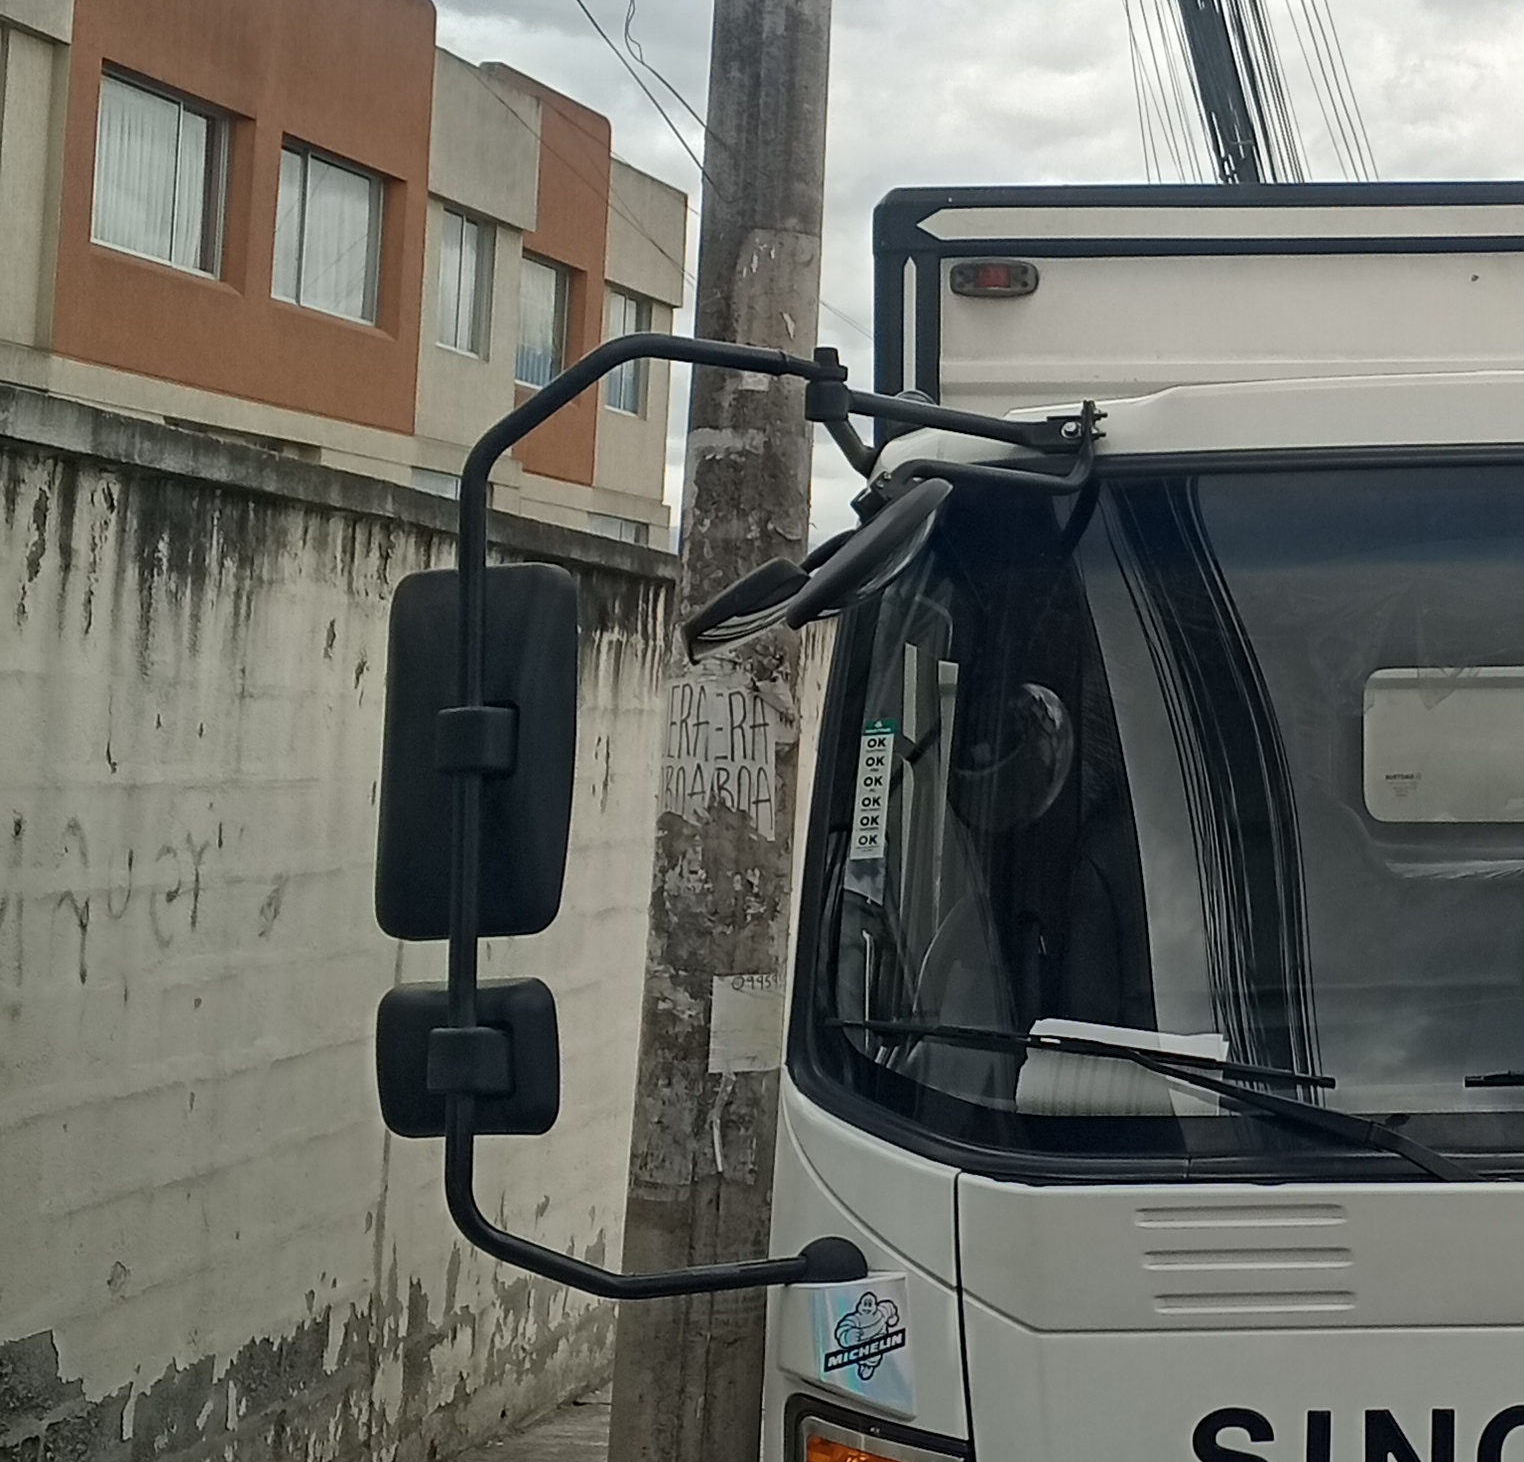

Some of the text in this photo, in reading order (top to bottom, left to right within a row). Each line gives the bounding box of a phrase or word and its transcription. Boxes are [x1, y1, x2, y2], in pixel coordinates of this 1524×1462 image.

[867, 737, 887, 749] OK
[865, 755, 886, 768] OK
[863, 775, 884, 788] OK
[861, 795, 882, 808] OK
[860, 815, 880, 827] OK
[858, 834, 878, 846] OK
[827, 1332, 904, 1368] MICHELIN
